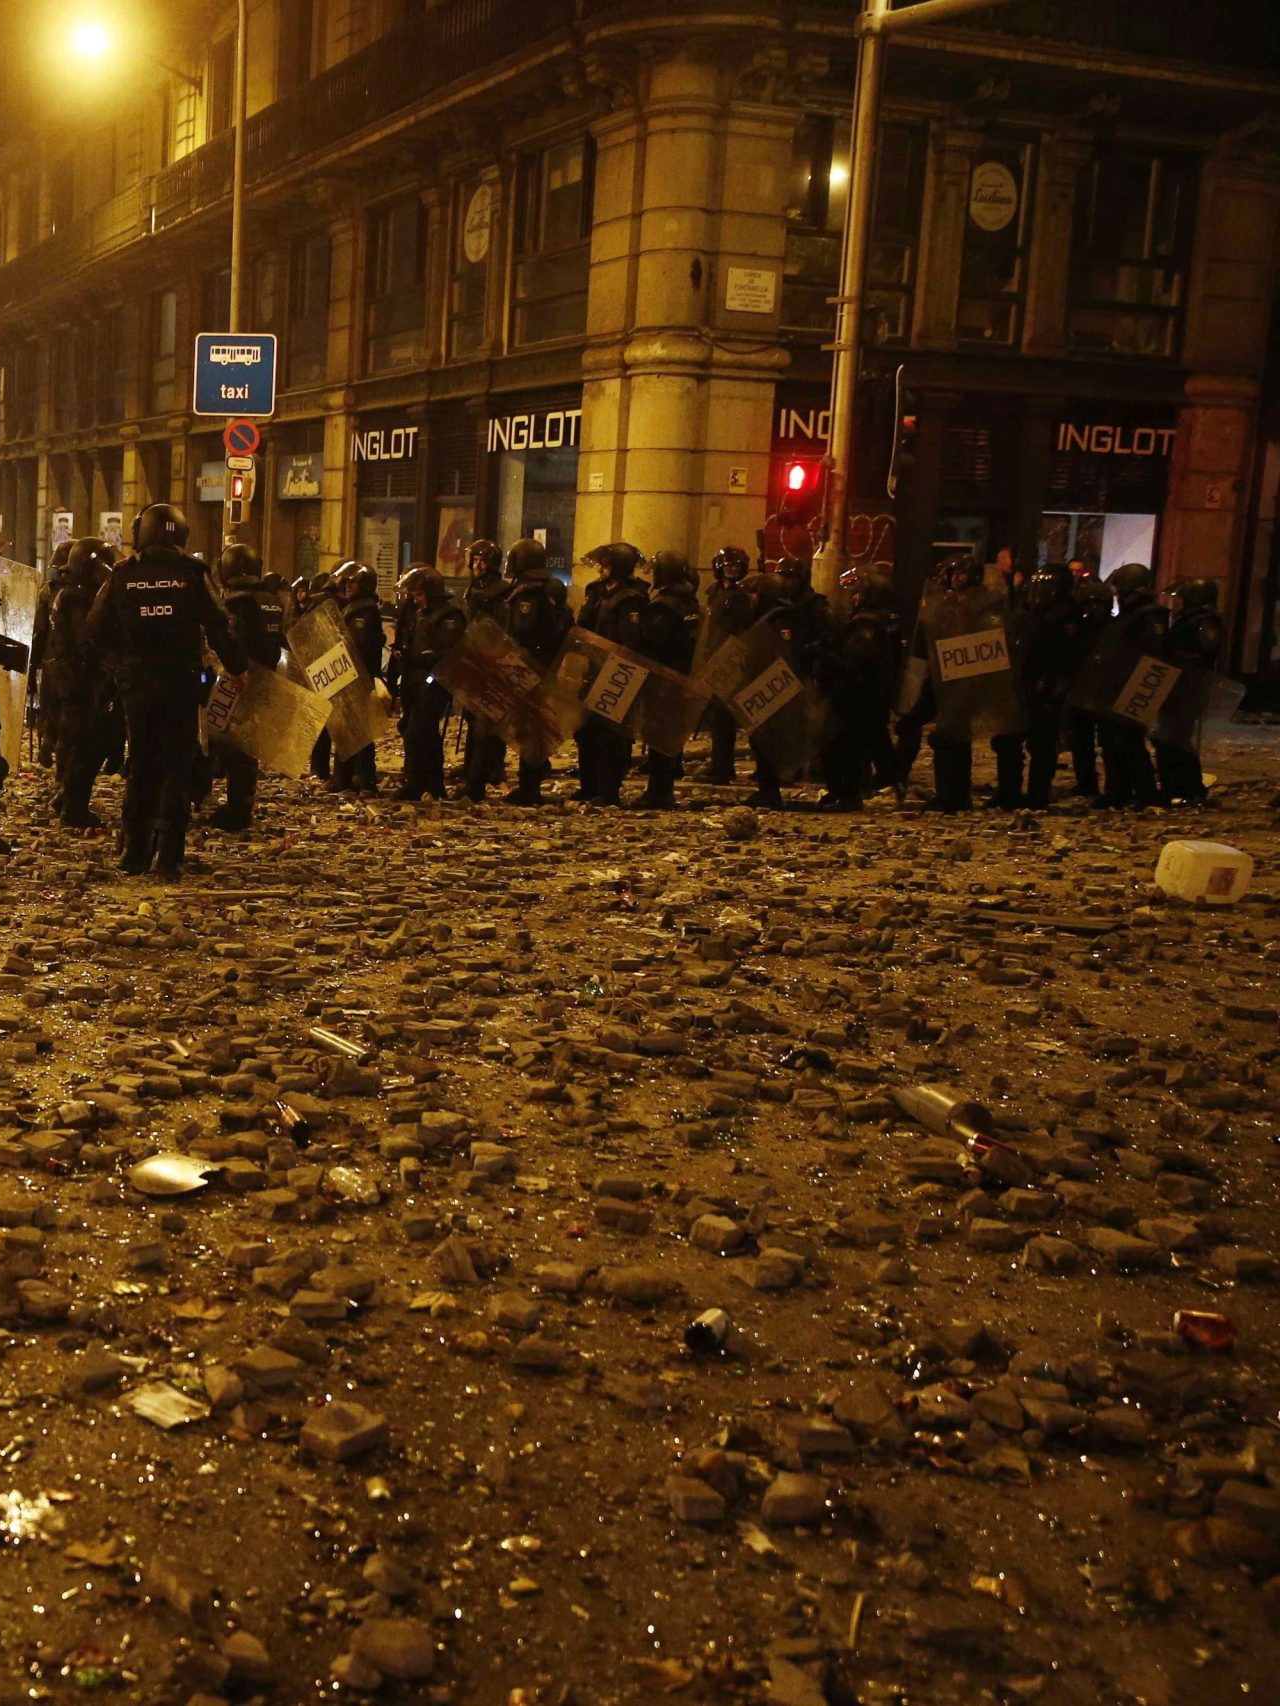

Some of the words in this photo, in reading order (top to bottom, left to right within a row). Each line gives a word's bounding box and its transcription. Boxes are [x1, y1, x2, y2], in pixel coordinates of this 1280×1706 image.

[220, 383, 249, 399] taxi
[487, 409, 582, 453] INGLOT
[780, 408, 831, 439] ING
[1057, 422, 1177, 456] INGLOT
[350, 426, 419, 462] INGLOT
[126, 579, 180, 590] POLICIA
[942, 640, 1006, 668] POLICIA
[312, 653, 352, 692] POLICIA
[594, 662, 638, 716] POLICIA
[743, 669, 796, 717] POLICIA
[1125, 664, 1169, 719] POLICIA
